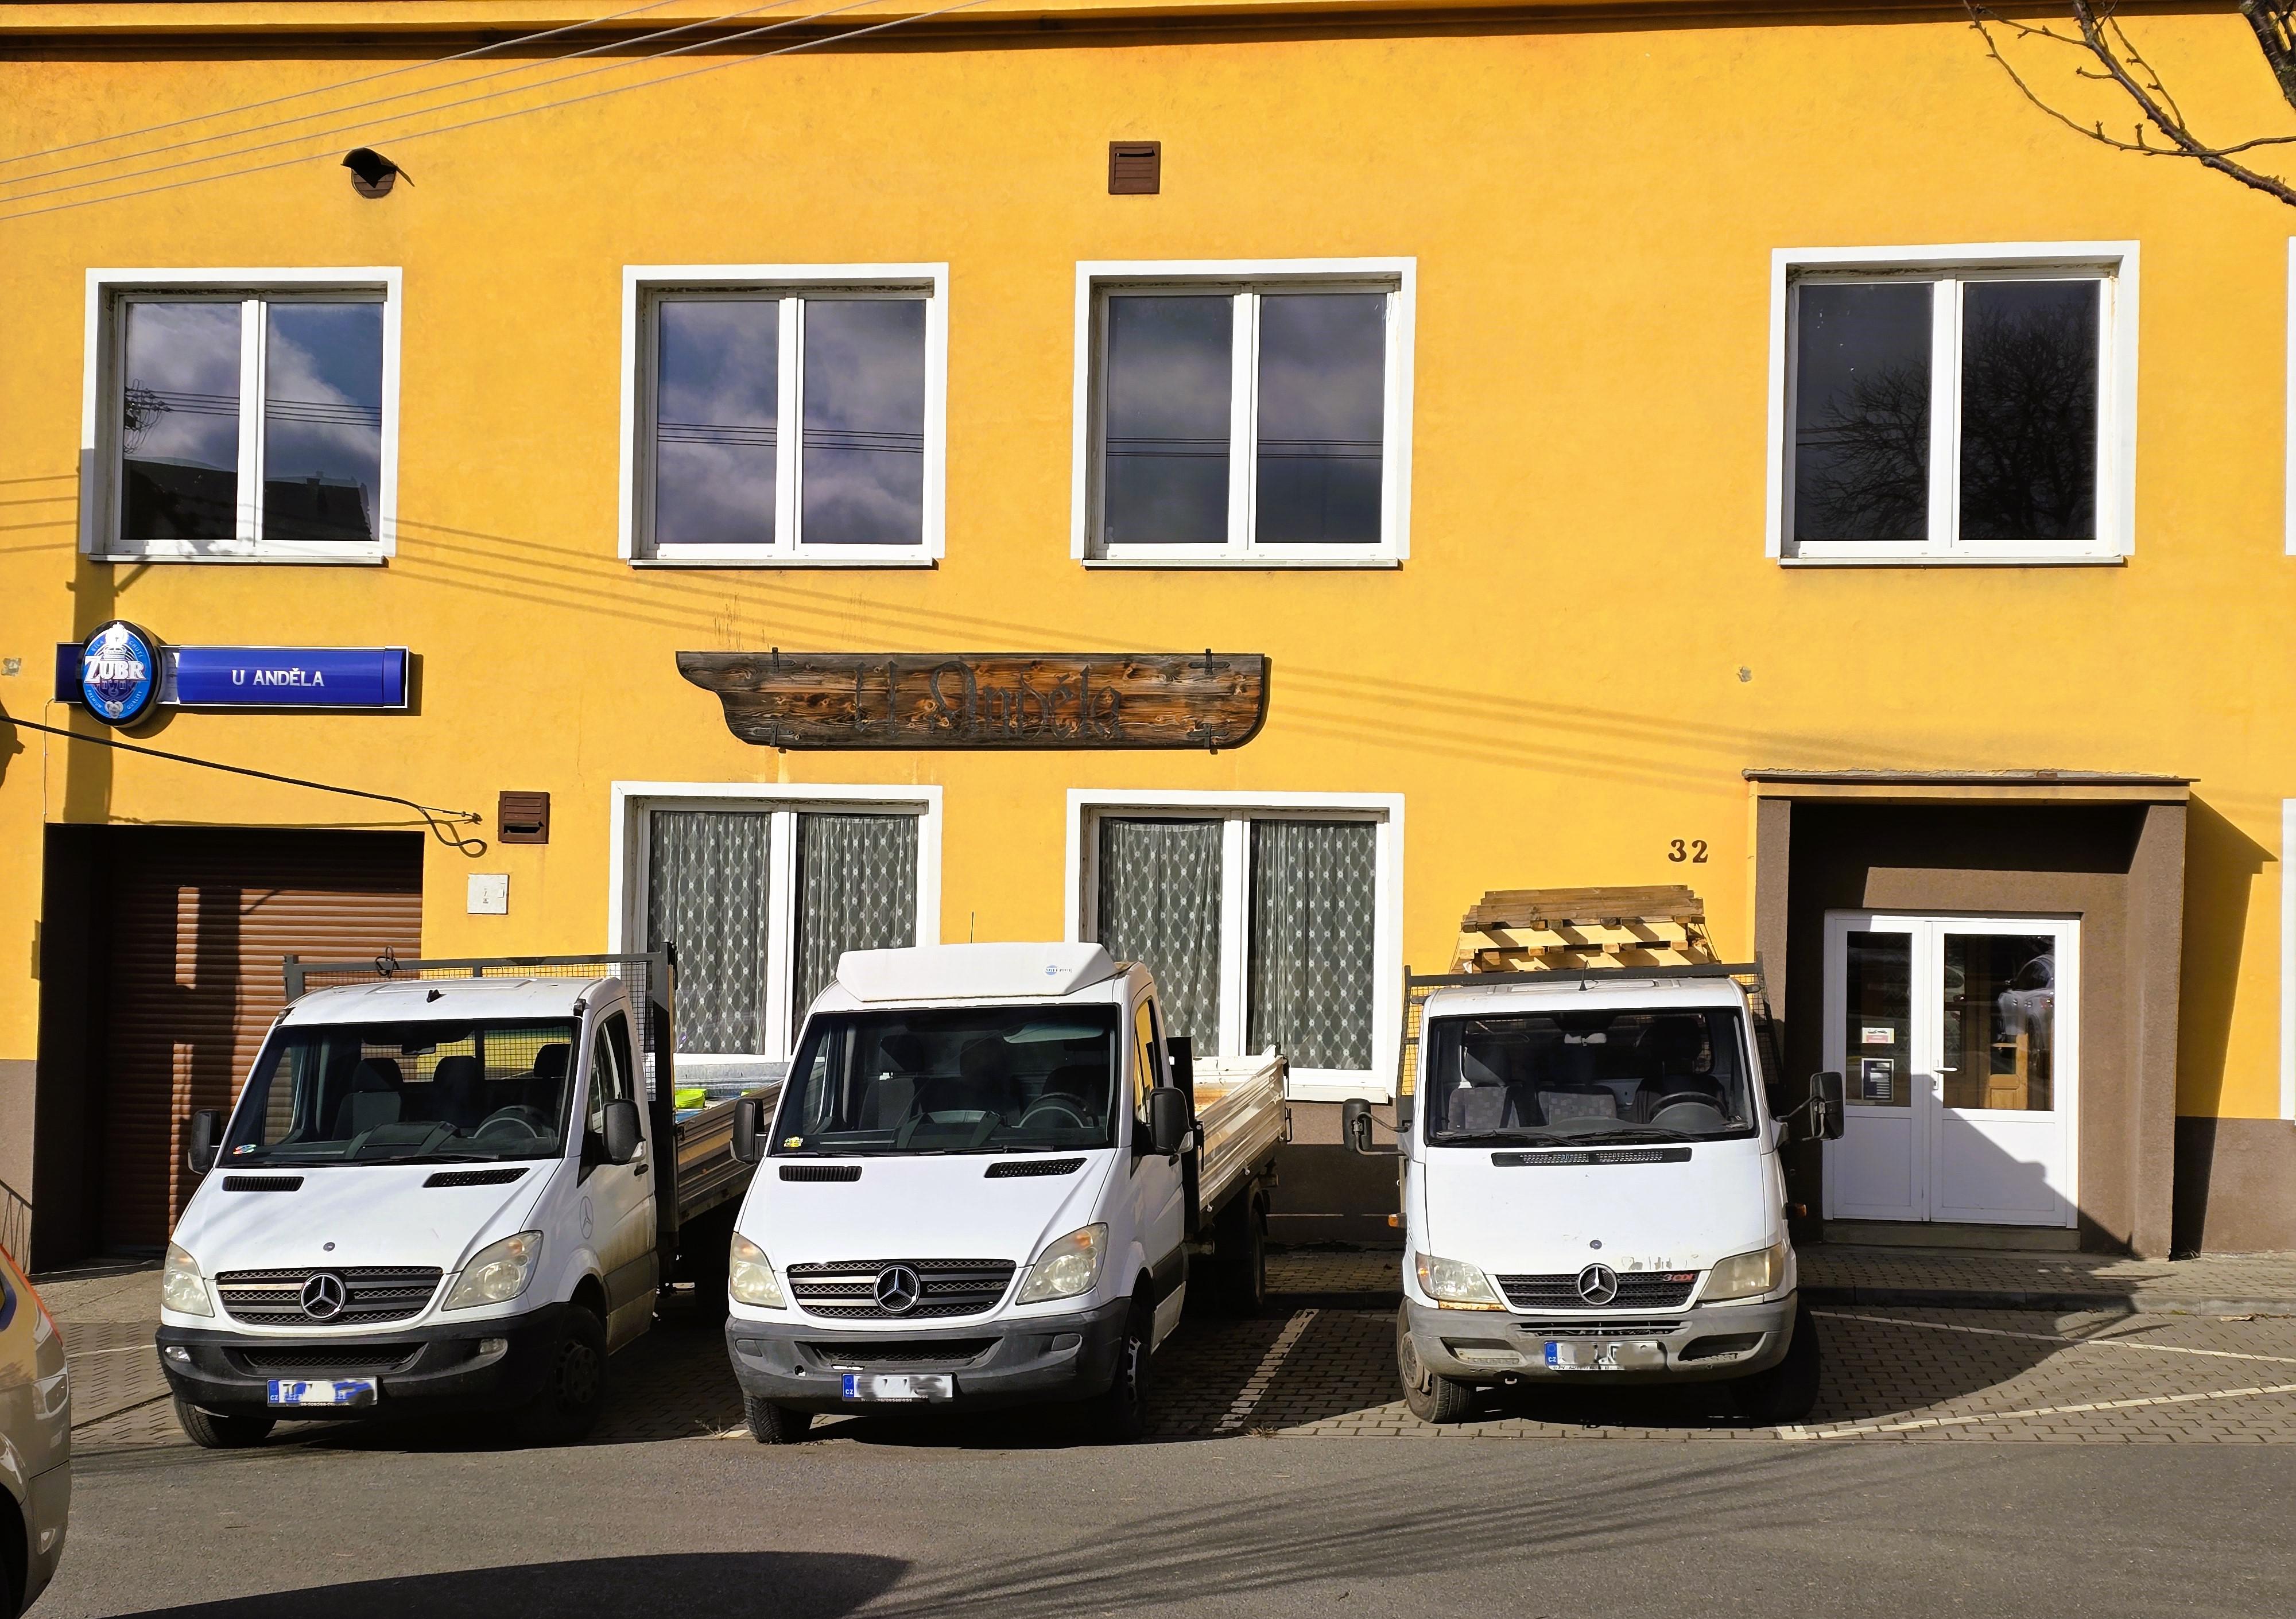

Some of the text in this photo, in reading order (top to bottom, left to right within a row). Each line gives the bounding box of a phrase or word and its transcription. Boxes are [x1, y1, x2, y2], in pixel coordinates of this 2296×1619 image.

[84, 655, 149, 684] ZUBR
[232, 667, 325, 686] U ANDĚLA
[1667, 839, 1708, 863] 32
